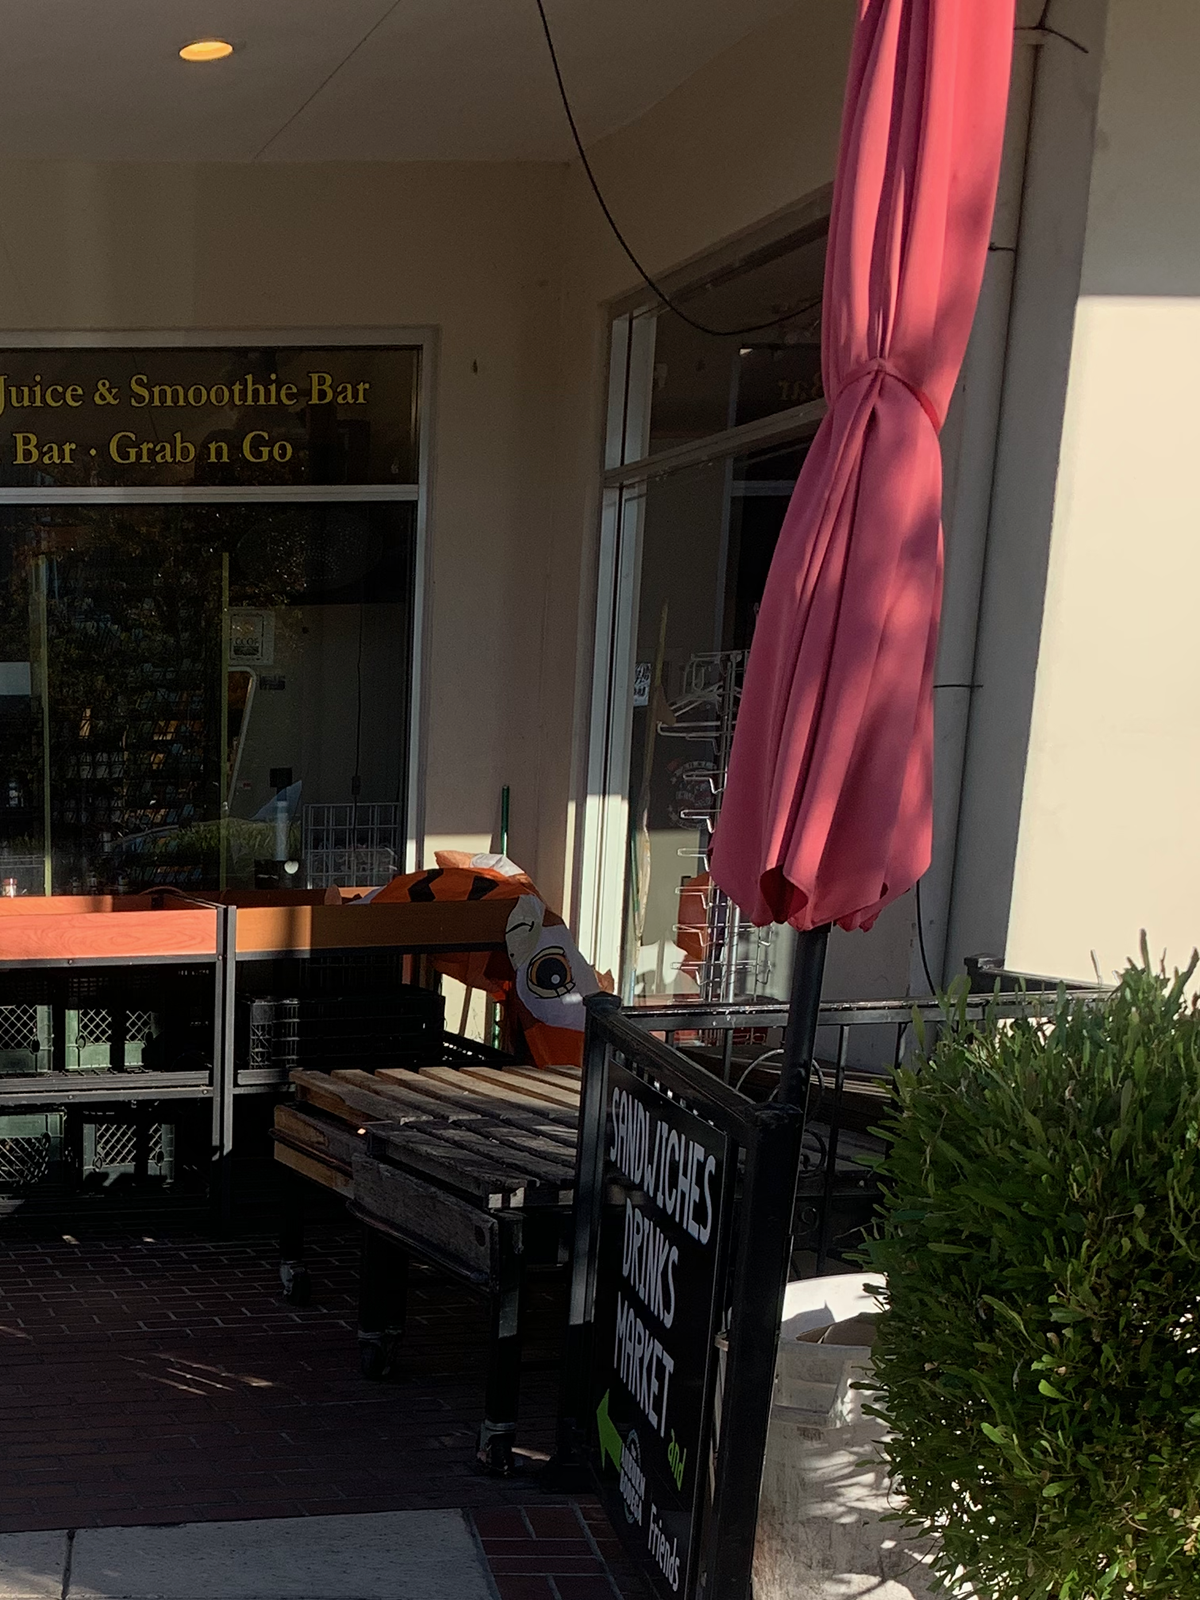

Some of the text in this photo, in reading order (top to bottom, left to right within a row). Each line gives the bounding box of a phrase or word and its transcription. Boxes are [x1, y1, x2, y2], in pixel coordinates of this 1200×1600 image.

[93, 378, 120, 406] &
[130, 372, 298, 407] Smoothie
[308, 372, 370, 405] Bar
[12, 432, 77, 465] Bar
[109, 430, 196, 464] Grab
[207, 441, 230, 463] n
[242, 430, 293, 464] Go
[610, 1086, 716, 1246] SANDWICHES
[622, 1198, 679, 1328] DRINKS
[613, 1290, 675, 1439] MARKET
[647, 1502, 680, 1593] Friends
